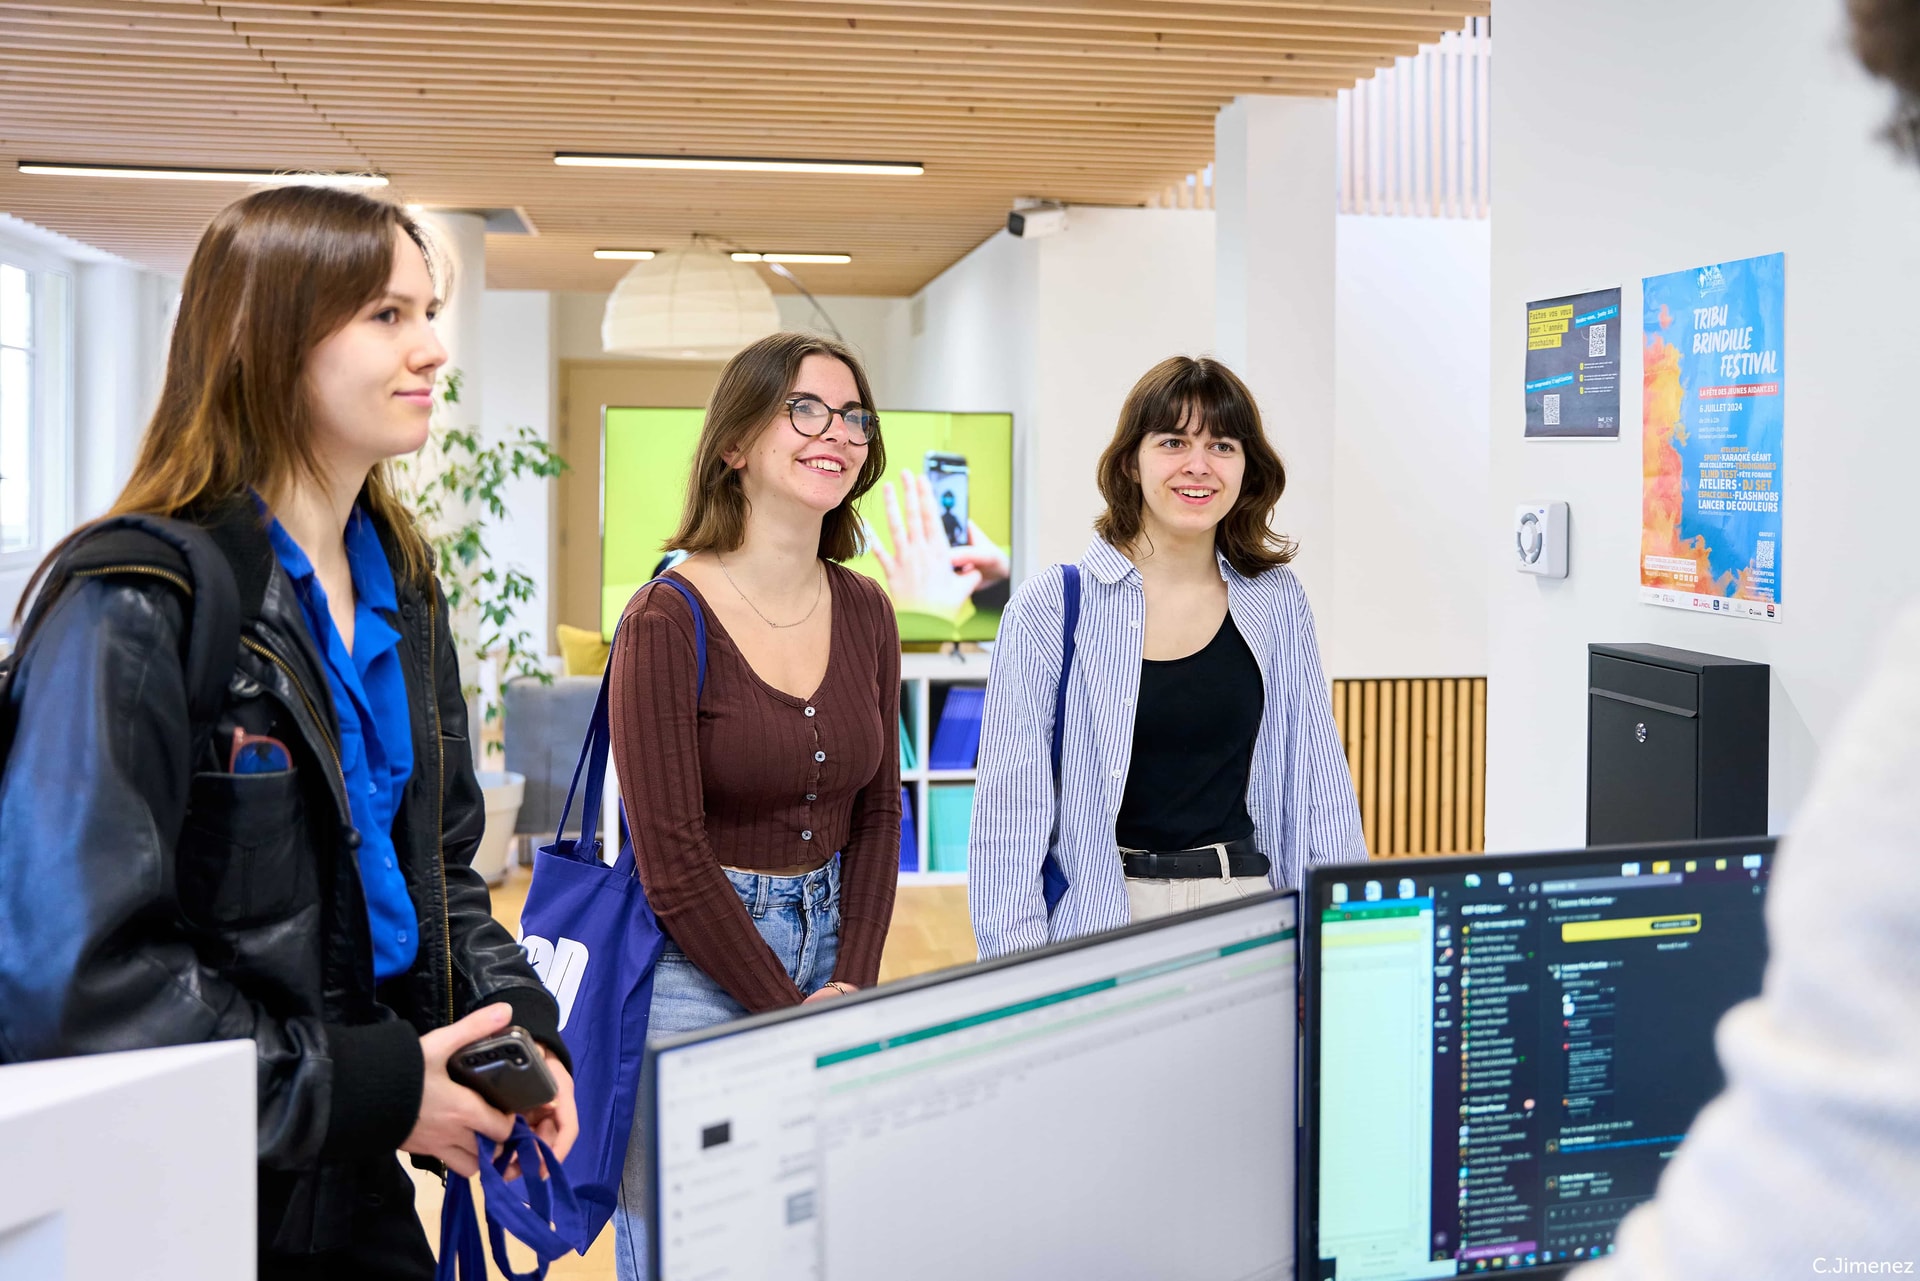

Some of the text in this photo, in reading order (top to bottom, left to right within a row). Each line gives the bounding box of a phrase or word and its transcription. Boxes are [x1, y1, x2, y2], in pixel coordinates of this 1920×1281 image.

[1693, 304, 1728, 330] TRIBU
[1692, 327, 1753, 354] BRINDILLE
[1721, 351, 1778, 379] FESTIVAL
[1707, 388, 1717, 396] FÊTE
[1704, 403, 1726, 412] JUILLET
[1727, 403, 1743, 411] 2024
[1722, 452, 1750, 461] KARAOKÉ
[1751, 451, 1772, 461] GÉANT
[1721, 470, 1737, 478] TEST
[1699, 478, 1772, 490] ATELIERS DJ SET
[1735, 491, 1779, 502] FLASHMOBS
[1698, 500, 1778, 512] LANCER DE COULEURS
